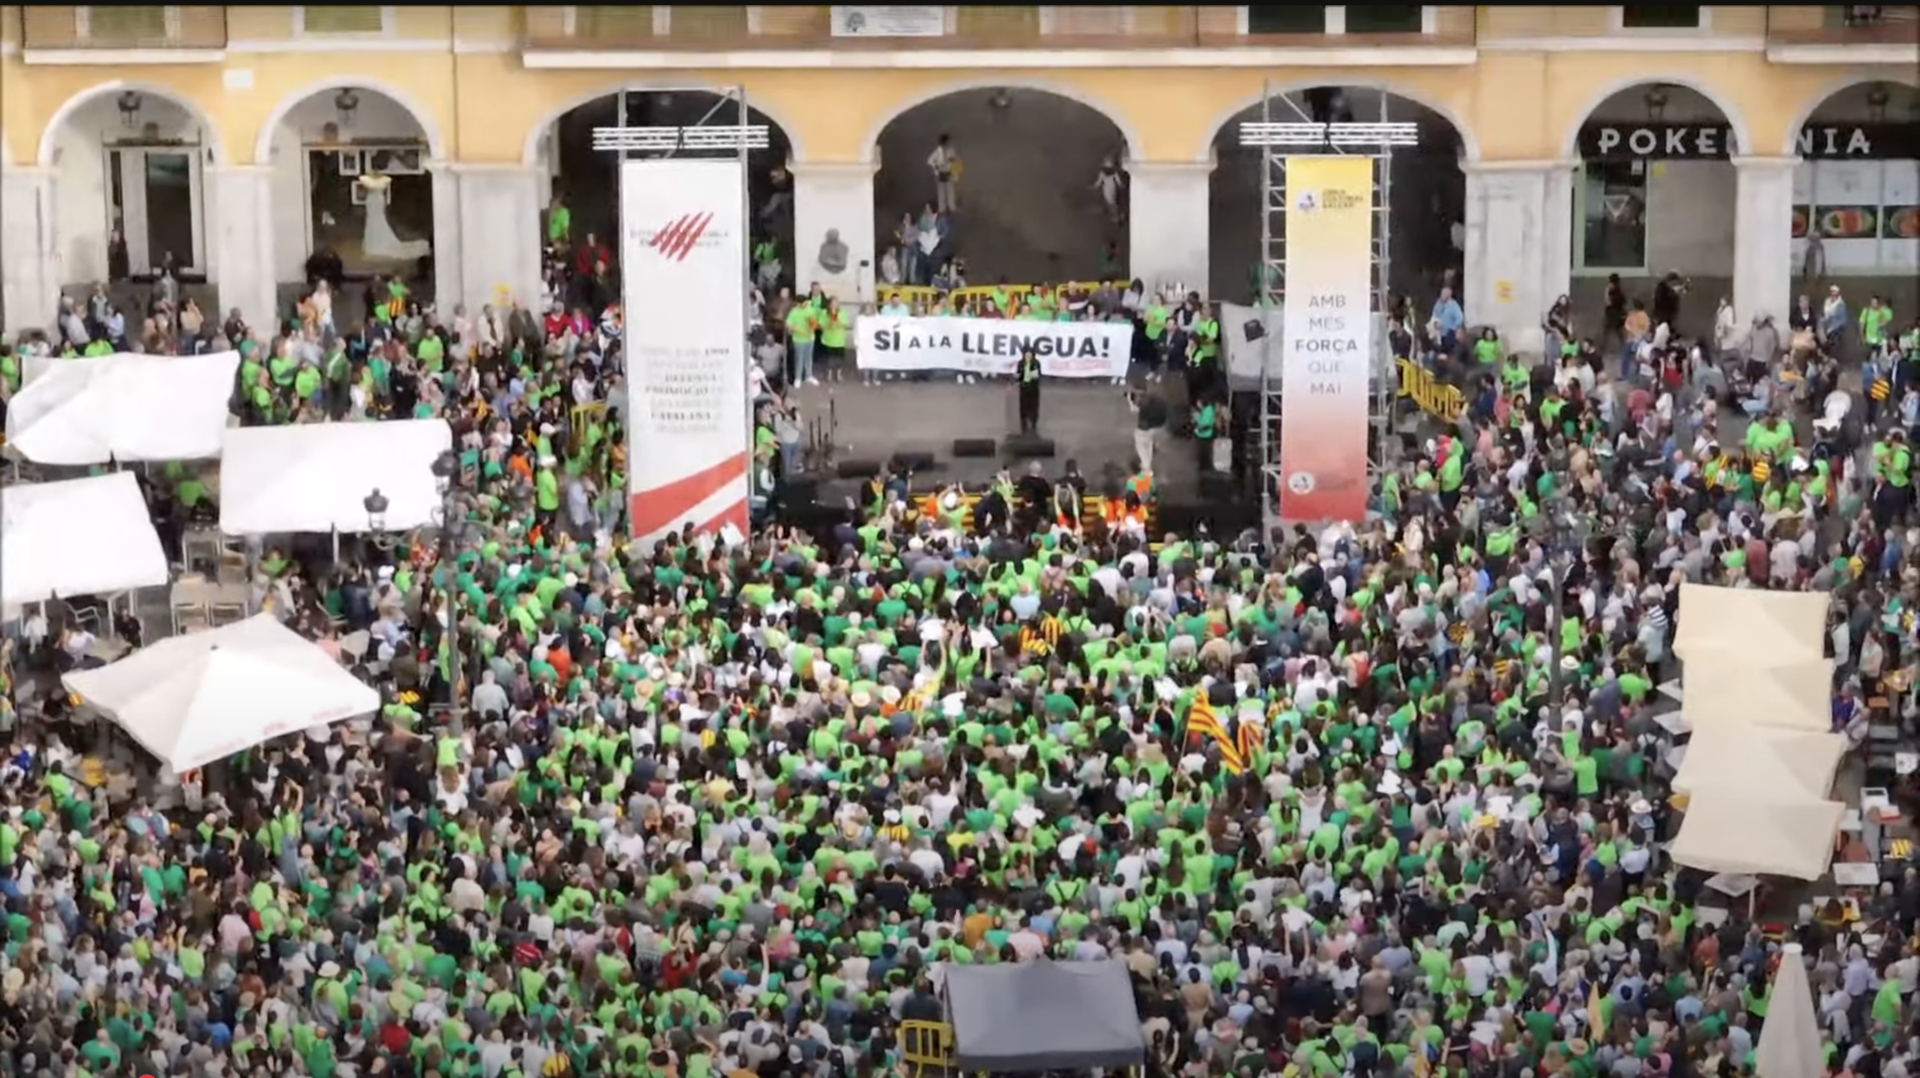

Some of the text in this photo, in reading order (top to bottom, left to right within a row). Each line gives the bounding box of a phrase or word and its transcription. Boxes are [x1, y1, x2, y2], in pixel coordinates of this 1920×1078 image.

[1308, 294, 1346, 308] AMB
[874, 322, 1110, 358] SÍ A LA LLENGUA!
[1295, 339, 1358, 355] FORÇA
[1307, 360, 1344, 374] QUE
[1310, 382, 1342, 395] MAI
